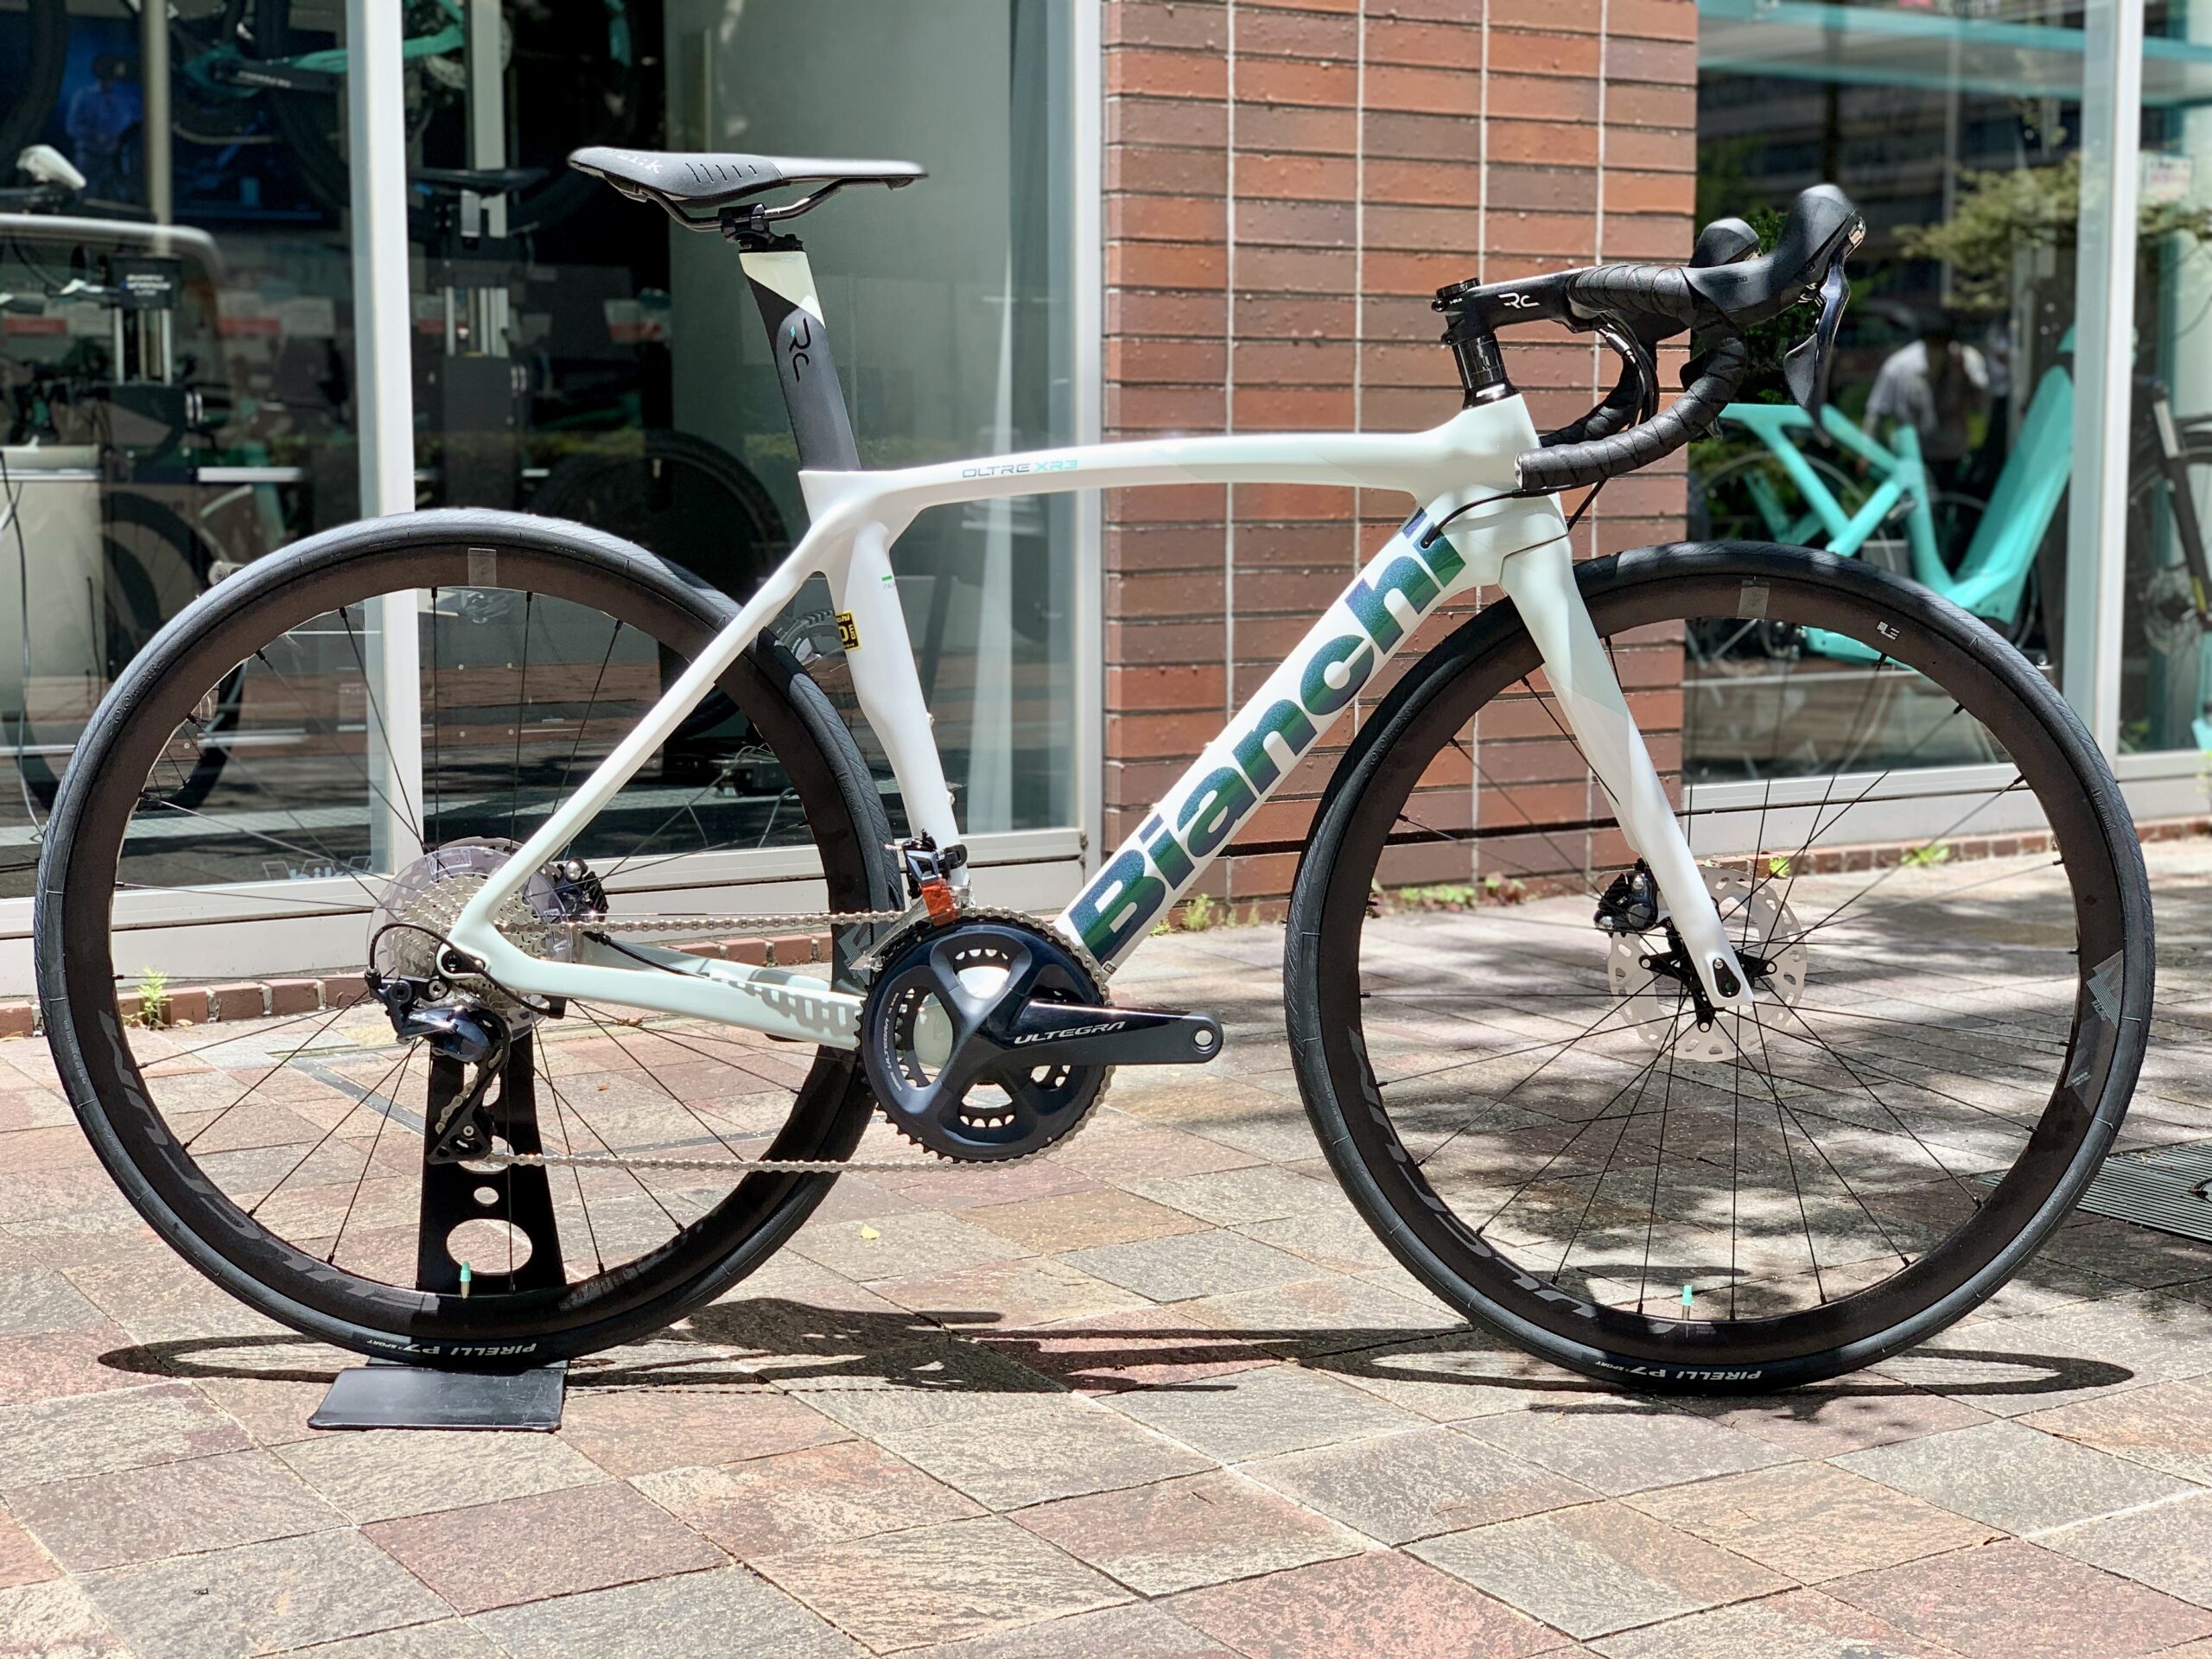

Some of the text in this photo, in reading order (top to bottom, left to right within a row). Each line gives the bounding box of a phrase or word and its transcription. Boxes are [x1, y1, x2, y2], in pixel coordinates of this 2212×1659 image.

[1497, 292, 1540, 309] RC
[788, 316, 811, 383] RC
[962, 460, 1078, 478] OLTRE XR3
[1068, 506, 1466, 965] Bianchi
[2091, 1000, 2110, 1020] RACING
[1014, 1021, 1126, 1044] ULTEGRA
[883, 1017, 893, 1070] ULTEGRA
[366, 1339, 398, 1350] SPORT
[449, 1343, 537, 1356] PIRELLI
[1595, 1360, 1625, 1372] SPORT
[1675, 1370, 1763, 1381] PIRELLI
